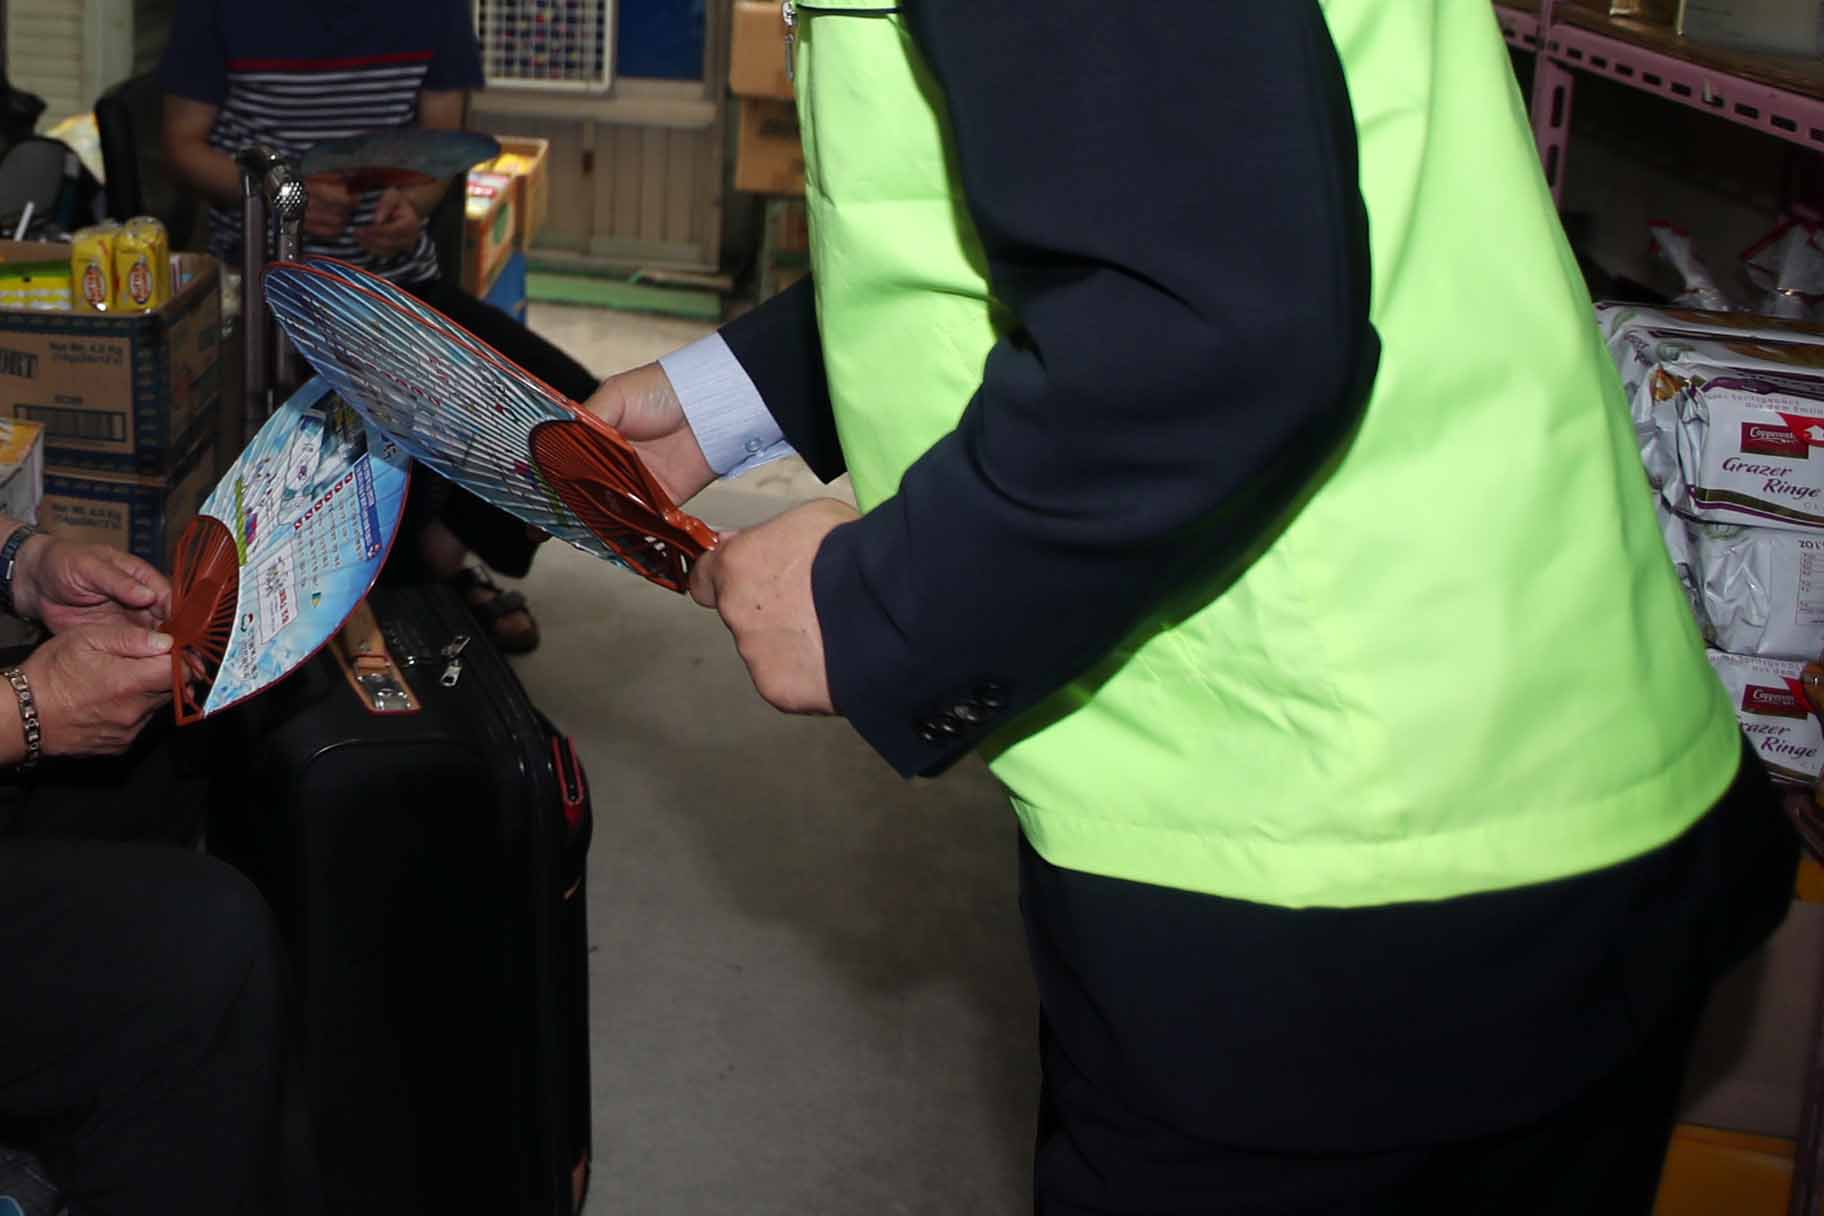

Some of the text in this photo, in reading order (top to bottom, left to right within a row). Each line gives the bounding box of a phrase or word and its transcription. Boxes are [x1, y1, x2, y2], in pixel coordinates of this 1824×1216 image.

[1722, 456, 1793, 480] Grazer
[1762, 478, 1822, 509] Ringe
[1738, 721, 1792, 738] razer
[1760, 738, 1817, 770] Ringe
